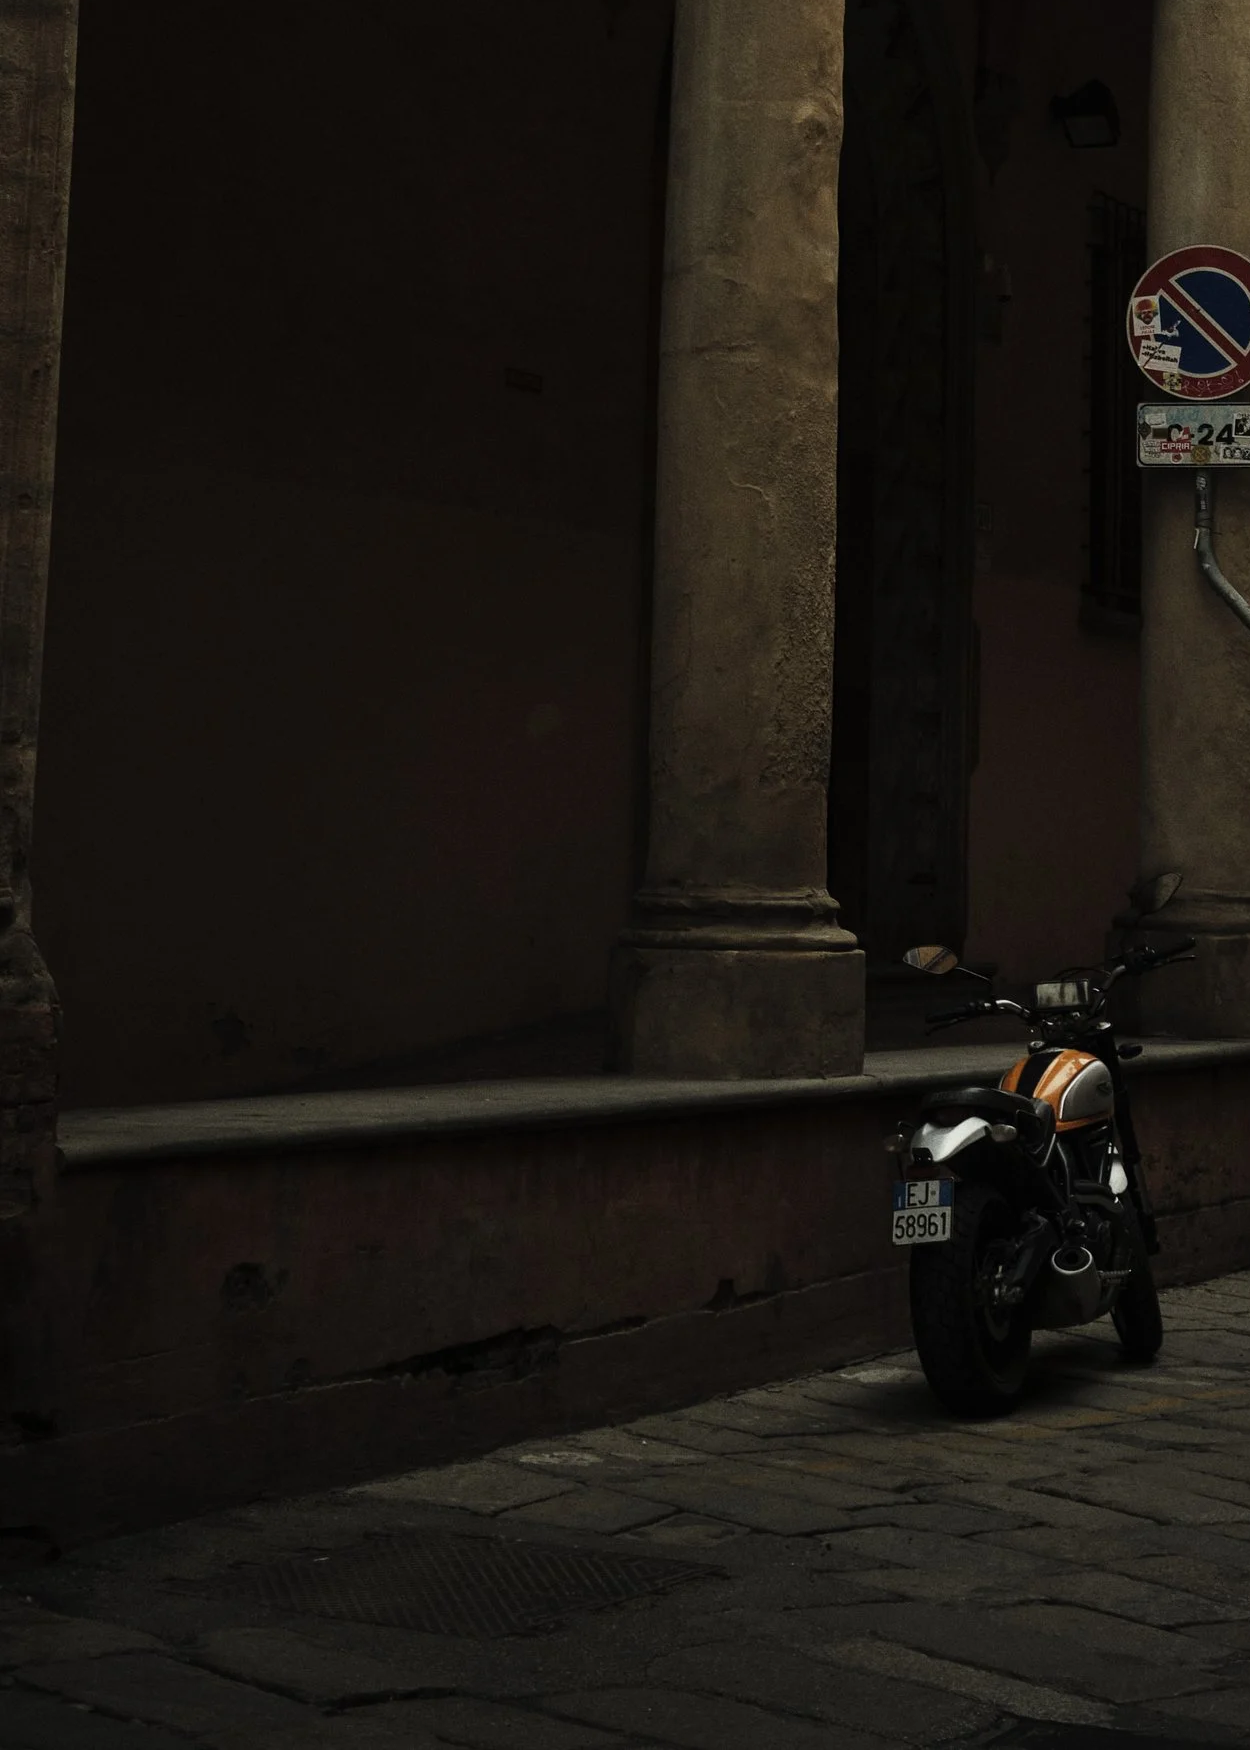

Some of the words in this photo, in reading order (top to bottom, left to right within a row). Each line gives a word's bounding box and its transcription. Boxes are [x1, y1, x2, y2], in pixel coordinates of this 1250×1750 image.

[1161, 442, 1190, 451] CIPRIA
[907, 1182, 930, 1207] EJ
[894, 1211, 947, 1240] 58961
